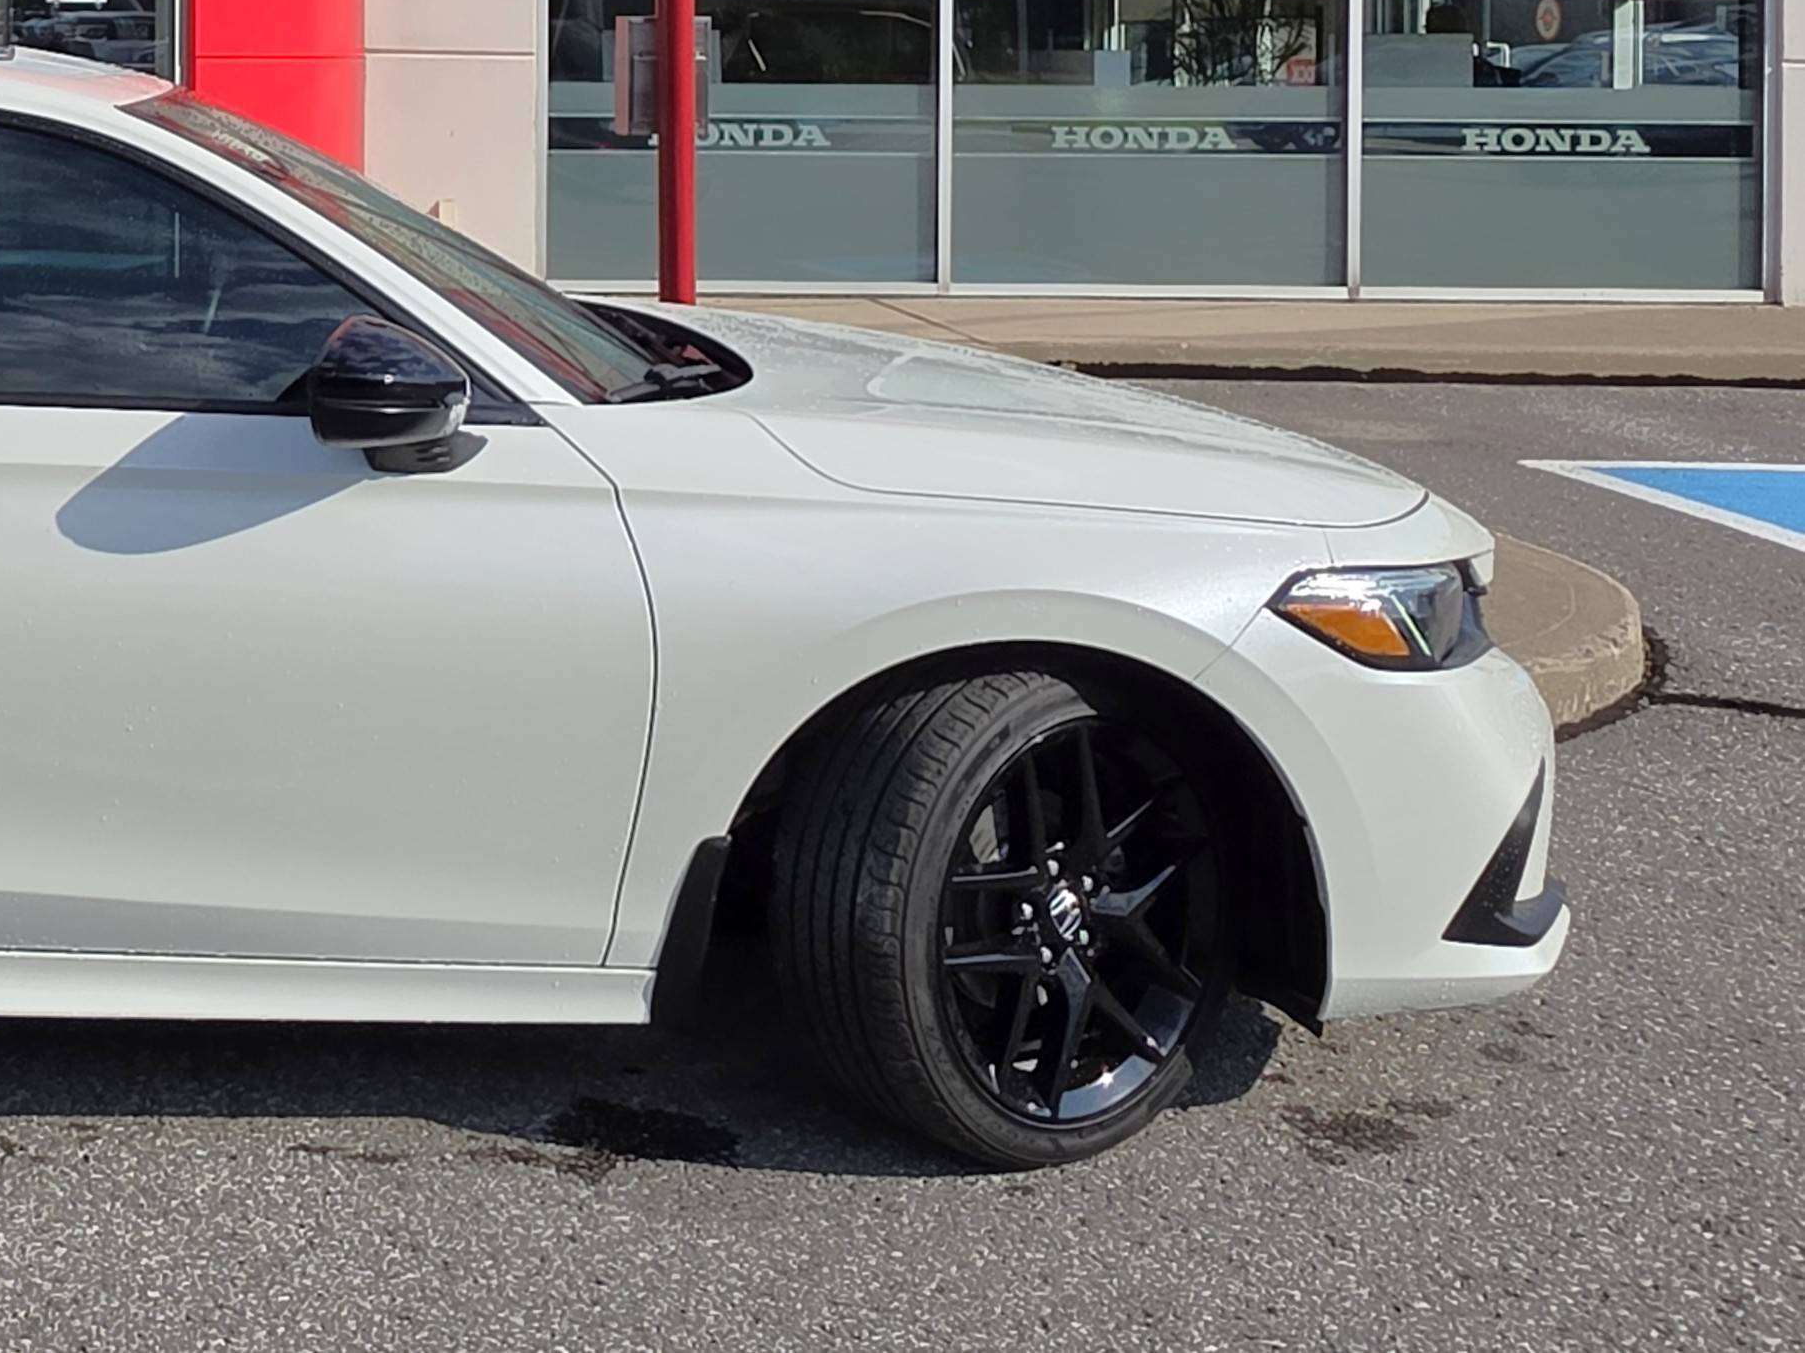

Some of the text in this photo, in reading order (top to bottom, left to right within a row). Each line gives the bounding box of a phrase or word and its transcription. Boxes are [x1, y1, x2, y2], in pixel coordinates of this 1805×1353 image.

[648, 123, 832, 146] ONDA
[1051, 126, 1237, 150] HONDA
[1461, 128, 1651, 153] HONDA
